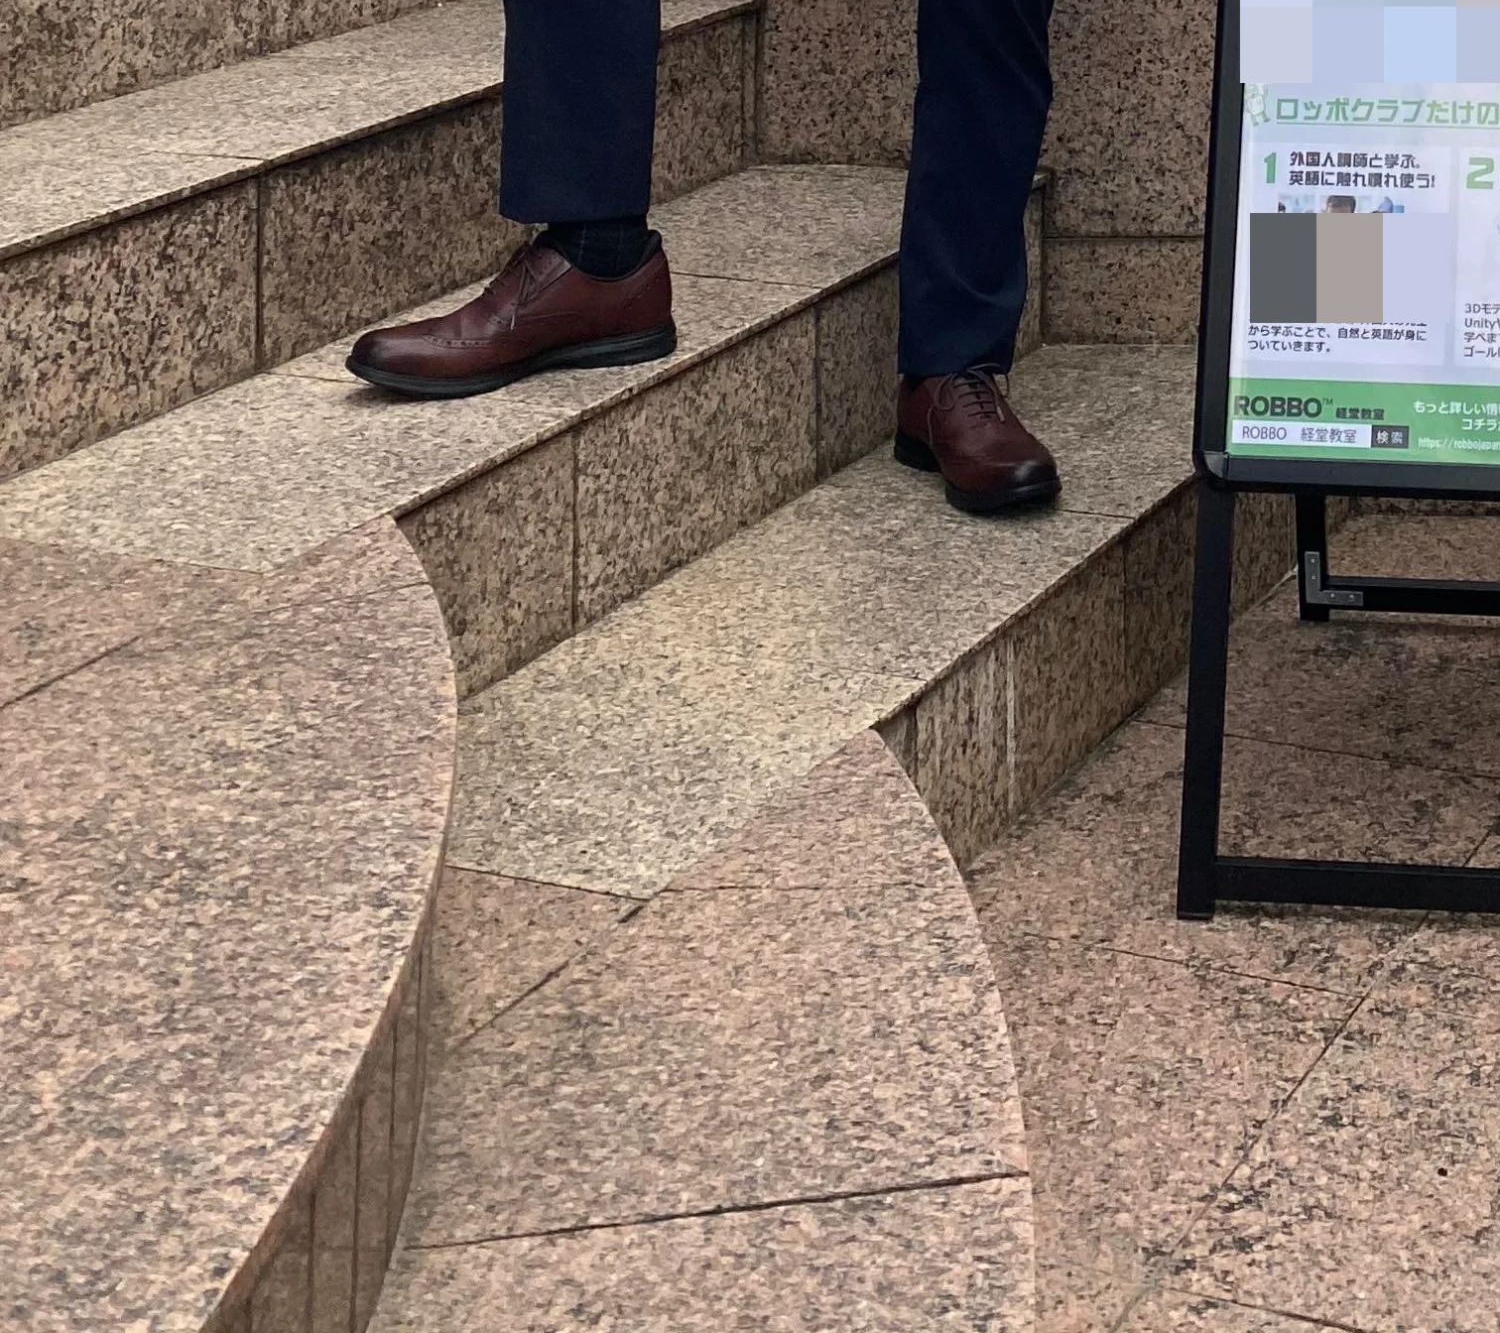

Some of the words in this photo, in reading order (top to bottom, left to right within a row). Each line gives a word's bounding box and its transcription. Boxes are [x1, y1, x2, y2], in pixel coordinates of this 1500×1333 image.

[1264, 152, 1277, 184] 1
[1466, 157, 1495, 190] 2
[1242, 426, 1287, 440] ROBBO
[1301, 427, 1357, 443] 経堂教室
[1376, 431, 1403, 445] 検索
